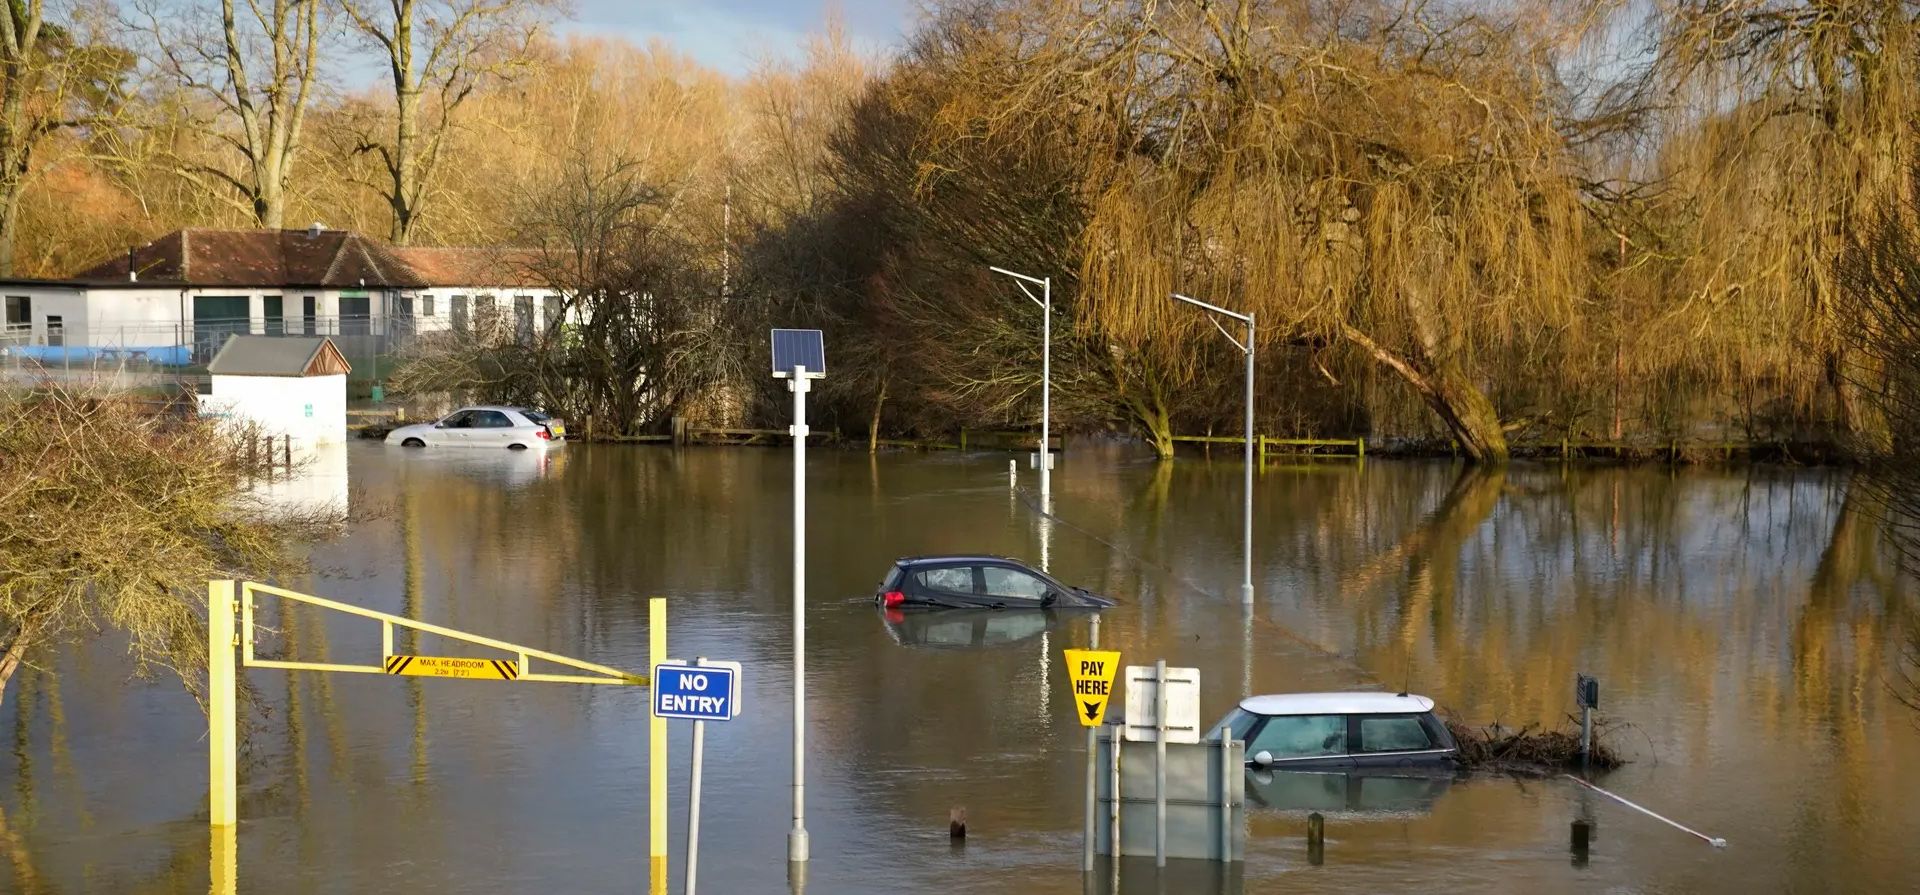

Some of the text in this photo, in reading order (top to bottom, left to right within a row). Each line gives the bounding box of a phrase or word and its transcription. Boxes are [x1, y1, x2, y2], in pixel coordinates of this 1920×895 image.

[441, 659, 484, 669] HEADROOM
[1081, 661, 1104, 676] PAY
[680, 673, 708, 691] NO
[1076, 680, 1109, 695] HERE
[661, 694, 725, 713] ENTRY
